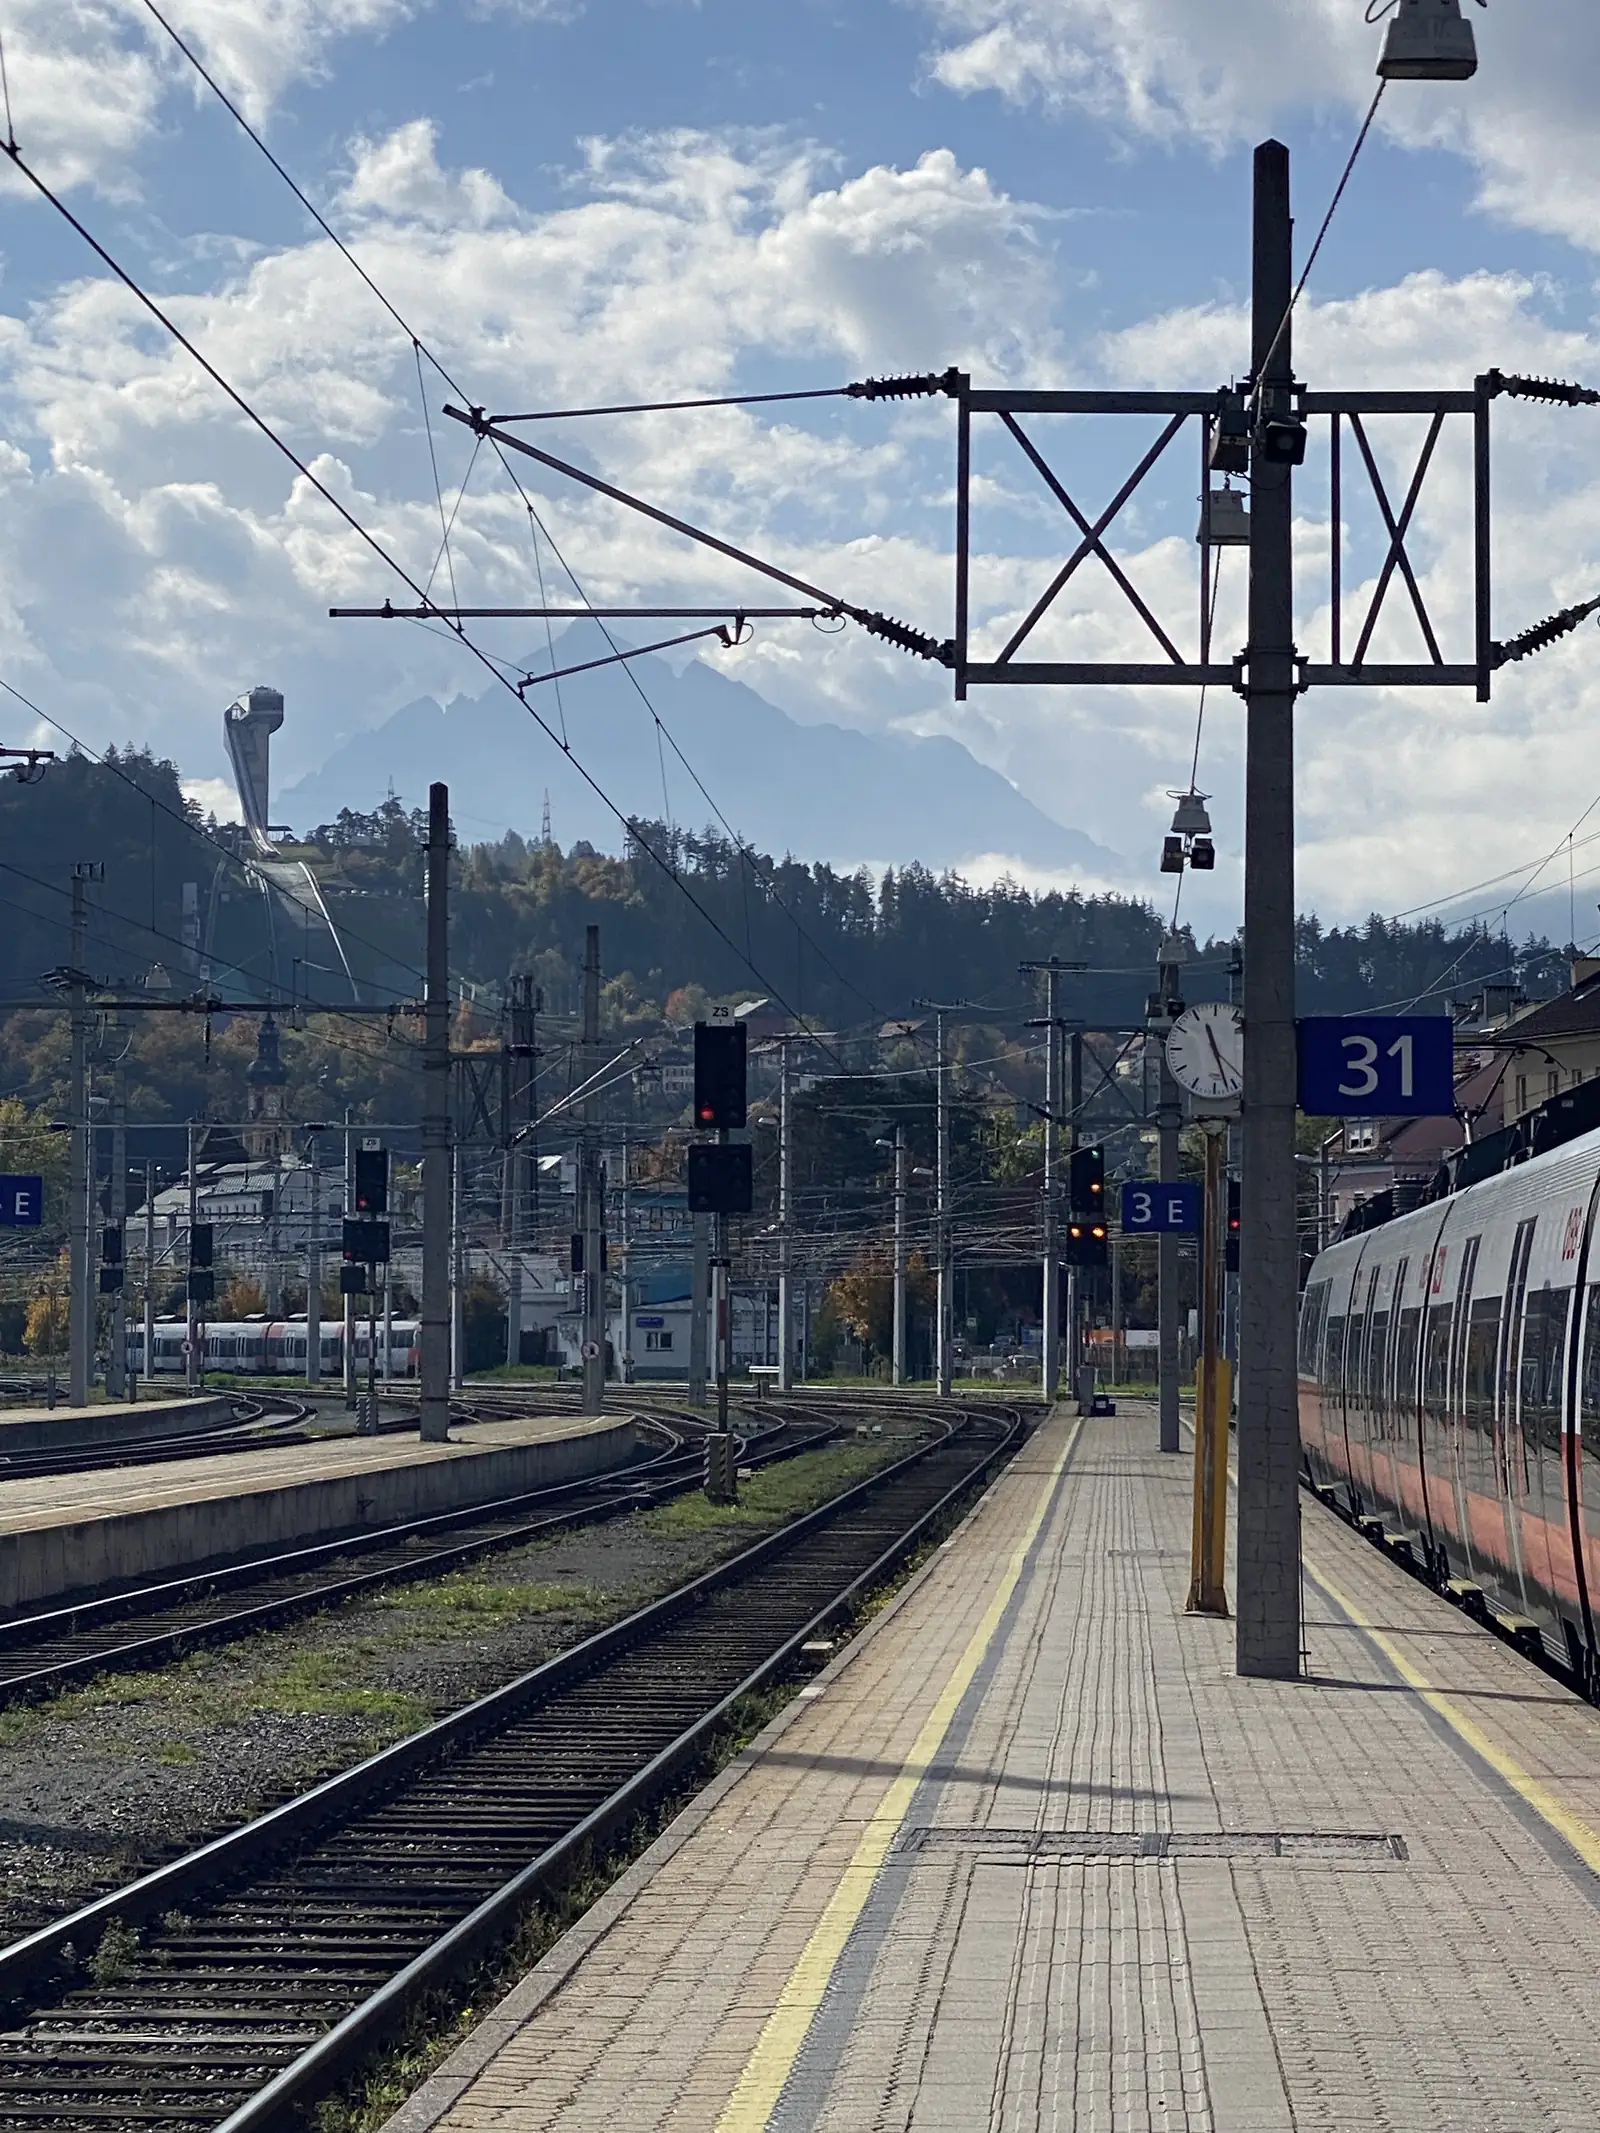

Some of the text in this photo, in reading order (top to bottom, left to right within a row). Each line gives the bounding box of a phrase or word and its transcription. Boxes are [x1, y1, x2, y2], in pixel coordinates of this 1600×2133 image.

[712, 1006, 728, 1017] ZS
[1338, 1035, 1413, 1096] 31
[15, 1192, 30, 1215] E
[1131, 1192, 1184, 1223] 3 E
